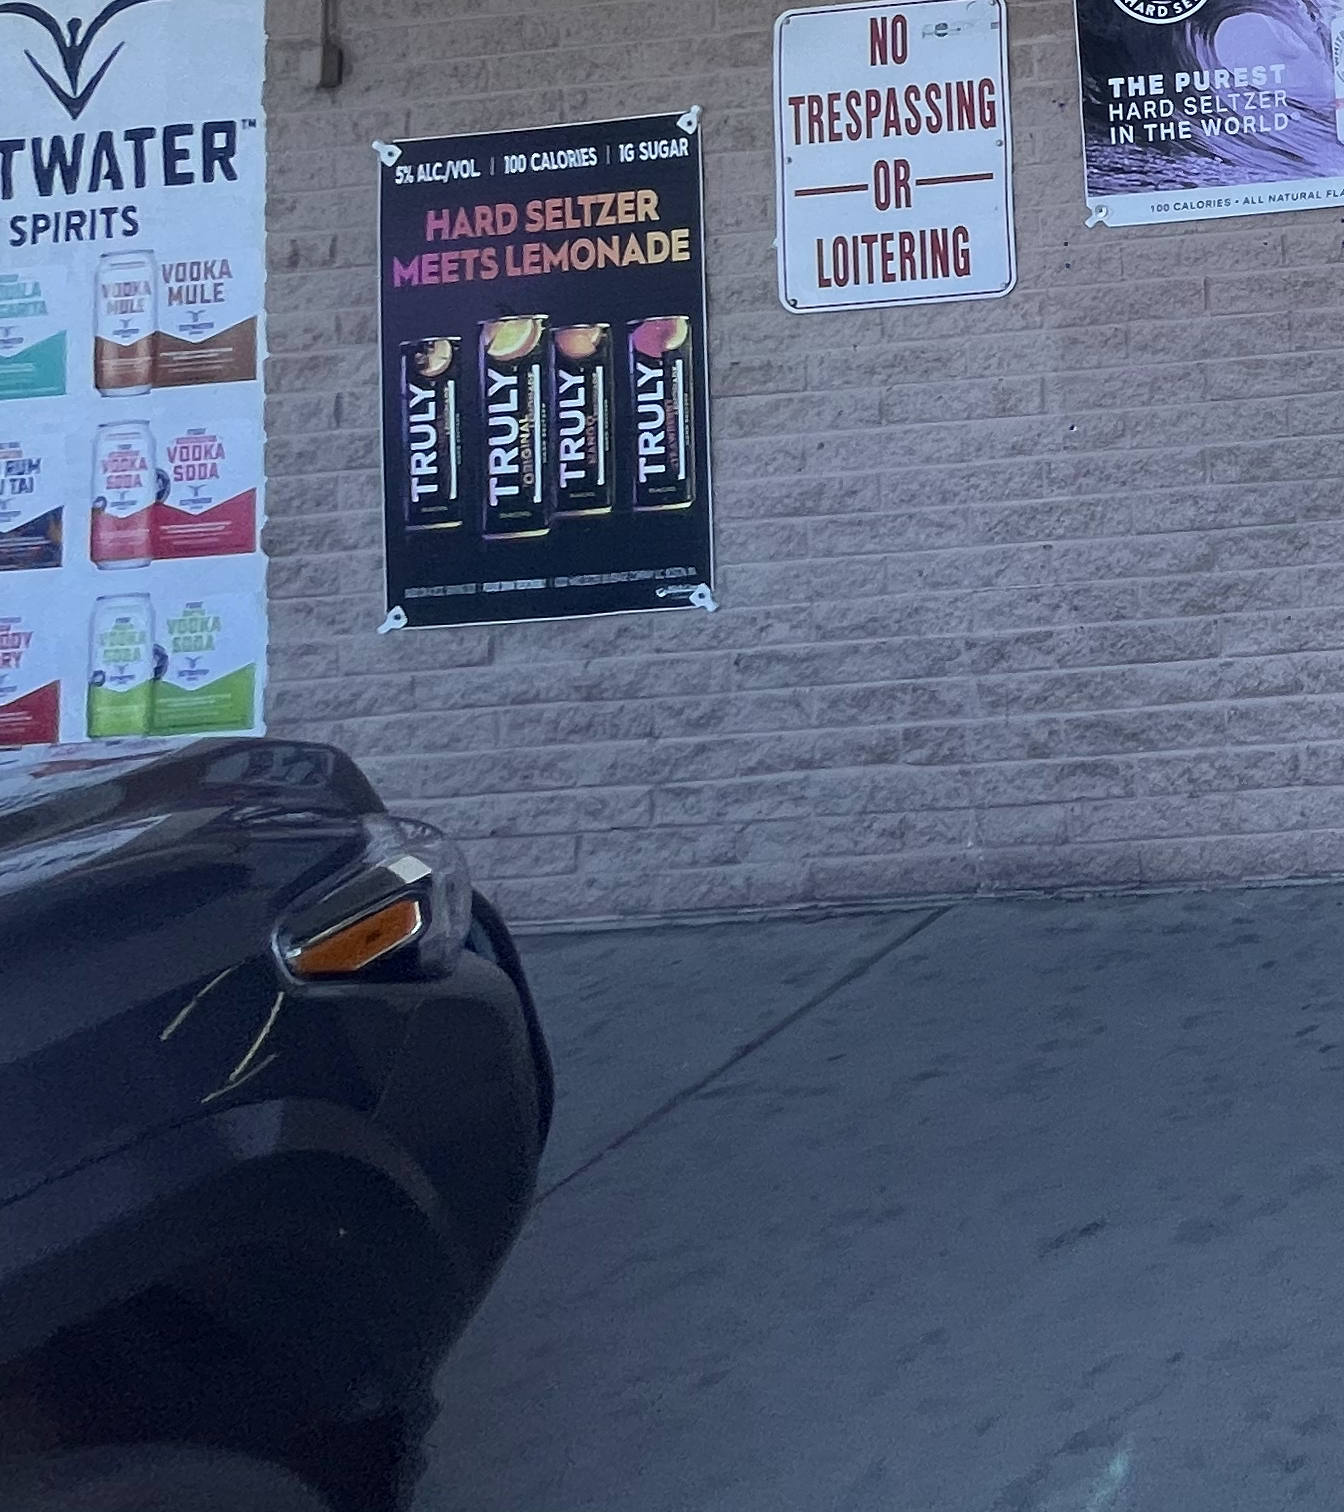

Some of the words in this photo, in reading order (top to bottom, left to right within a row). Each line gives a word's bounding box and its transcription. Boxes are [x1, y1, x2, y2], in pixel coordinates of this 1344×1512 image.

[869, 14, 908, 67] NO
[1108, 74, 1164, 98] THE
[1175, 63, 1286, 93] PUREST
[788, 78, 997, 146] TRESPASSING
[1109, 99, 1174, 122] HARD
[1184, 90, 1288, 116] SELTZER
[1110, 124, 1135, 145] IN
[1143, 120, 1192, 142] THE
[1200, 112, 1289, 138] WORLD
[395, 165, 415, 185] 5%
[503, 153, 528, 175] 100
[530, 147, 599, 173] CALORIES
[618, 143, 635, 164] 1G
[638, 137, 690, 161] SUGAR
[873, 158, 912, 211] OR
[9, 205, 140, 247] SPIRITS
[424, 202, 519, 242] HARD
[524, 188, 660, 234] SELTZER
[1150, 203, 1171, 214] 100
[1173, 197, 1232, 212] CALORIES
[1242, 195, 1264, 206] ALL
[1268, 190, 1322, 204] NATURAL
[161, 259, 233, 284] VODKA
[392, 246, 499, 288] MEETS
[504, 228, 691, 277] LEMONADE
[815, 225, 972, 289] LOITERING
[167, 282, 226, 306] MULE
[408, 382, 439, 504] TRULY
[487, 366, 520, 507] TRULY
[558, 368, 586, 489] TRULY
[635, 361, 667, 484] TRULY
[166, 442, 226, 464] VODKA
[172, 462, 220, 482] SODA
